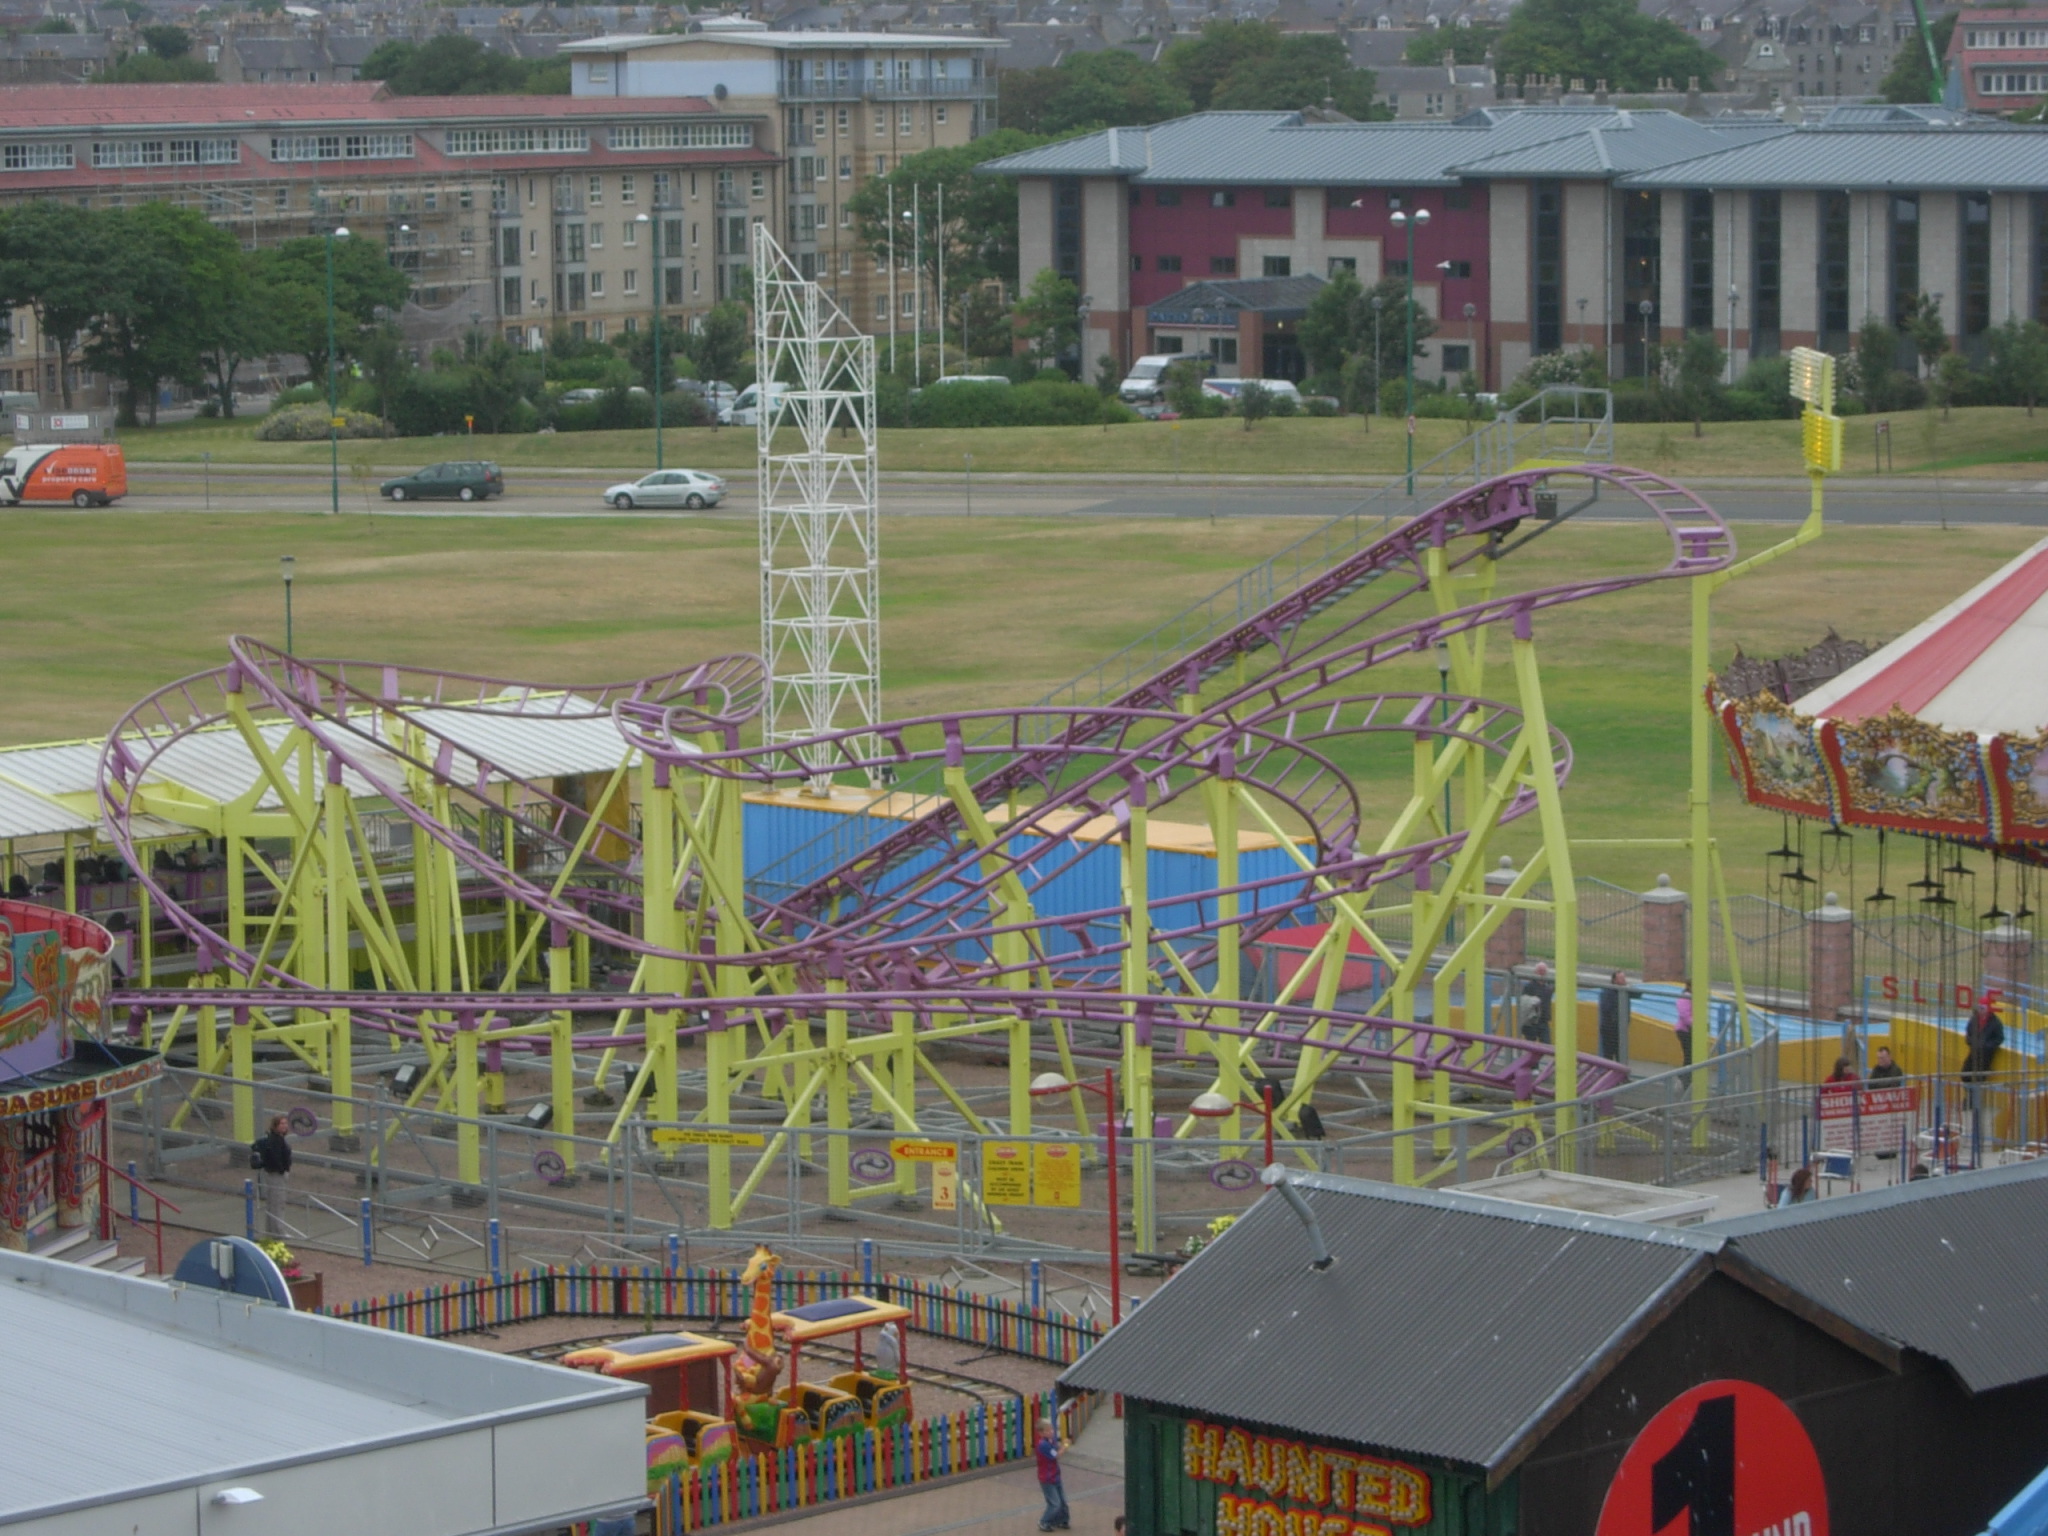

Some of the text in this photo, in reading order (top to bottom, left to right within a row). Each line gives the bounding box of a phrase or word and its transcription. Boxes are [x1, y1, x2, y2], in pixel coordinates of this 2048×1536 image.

[1882, 976, 2004, 1013] SLIDE
[1871, 1090, 1909, 1104] WAVE
[904, 1146, 948, 1157] ENTRANCE
[940, 1186, 949, 1200] 3
[1183, 1419, 1432, 1528] HAUNTED
[1652, 1393, 1736, 1536] 1
[1215, 1493, 1392, 1536] HOU
